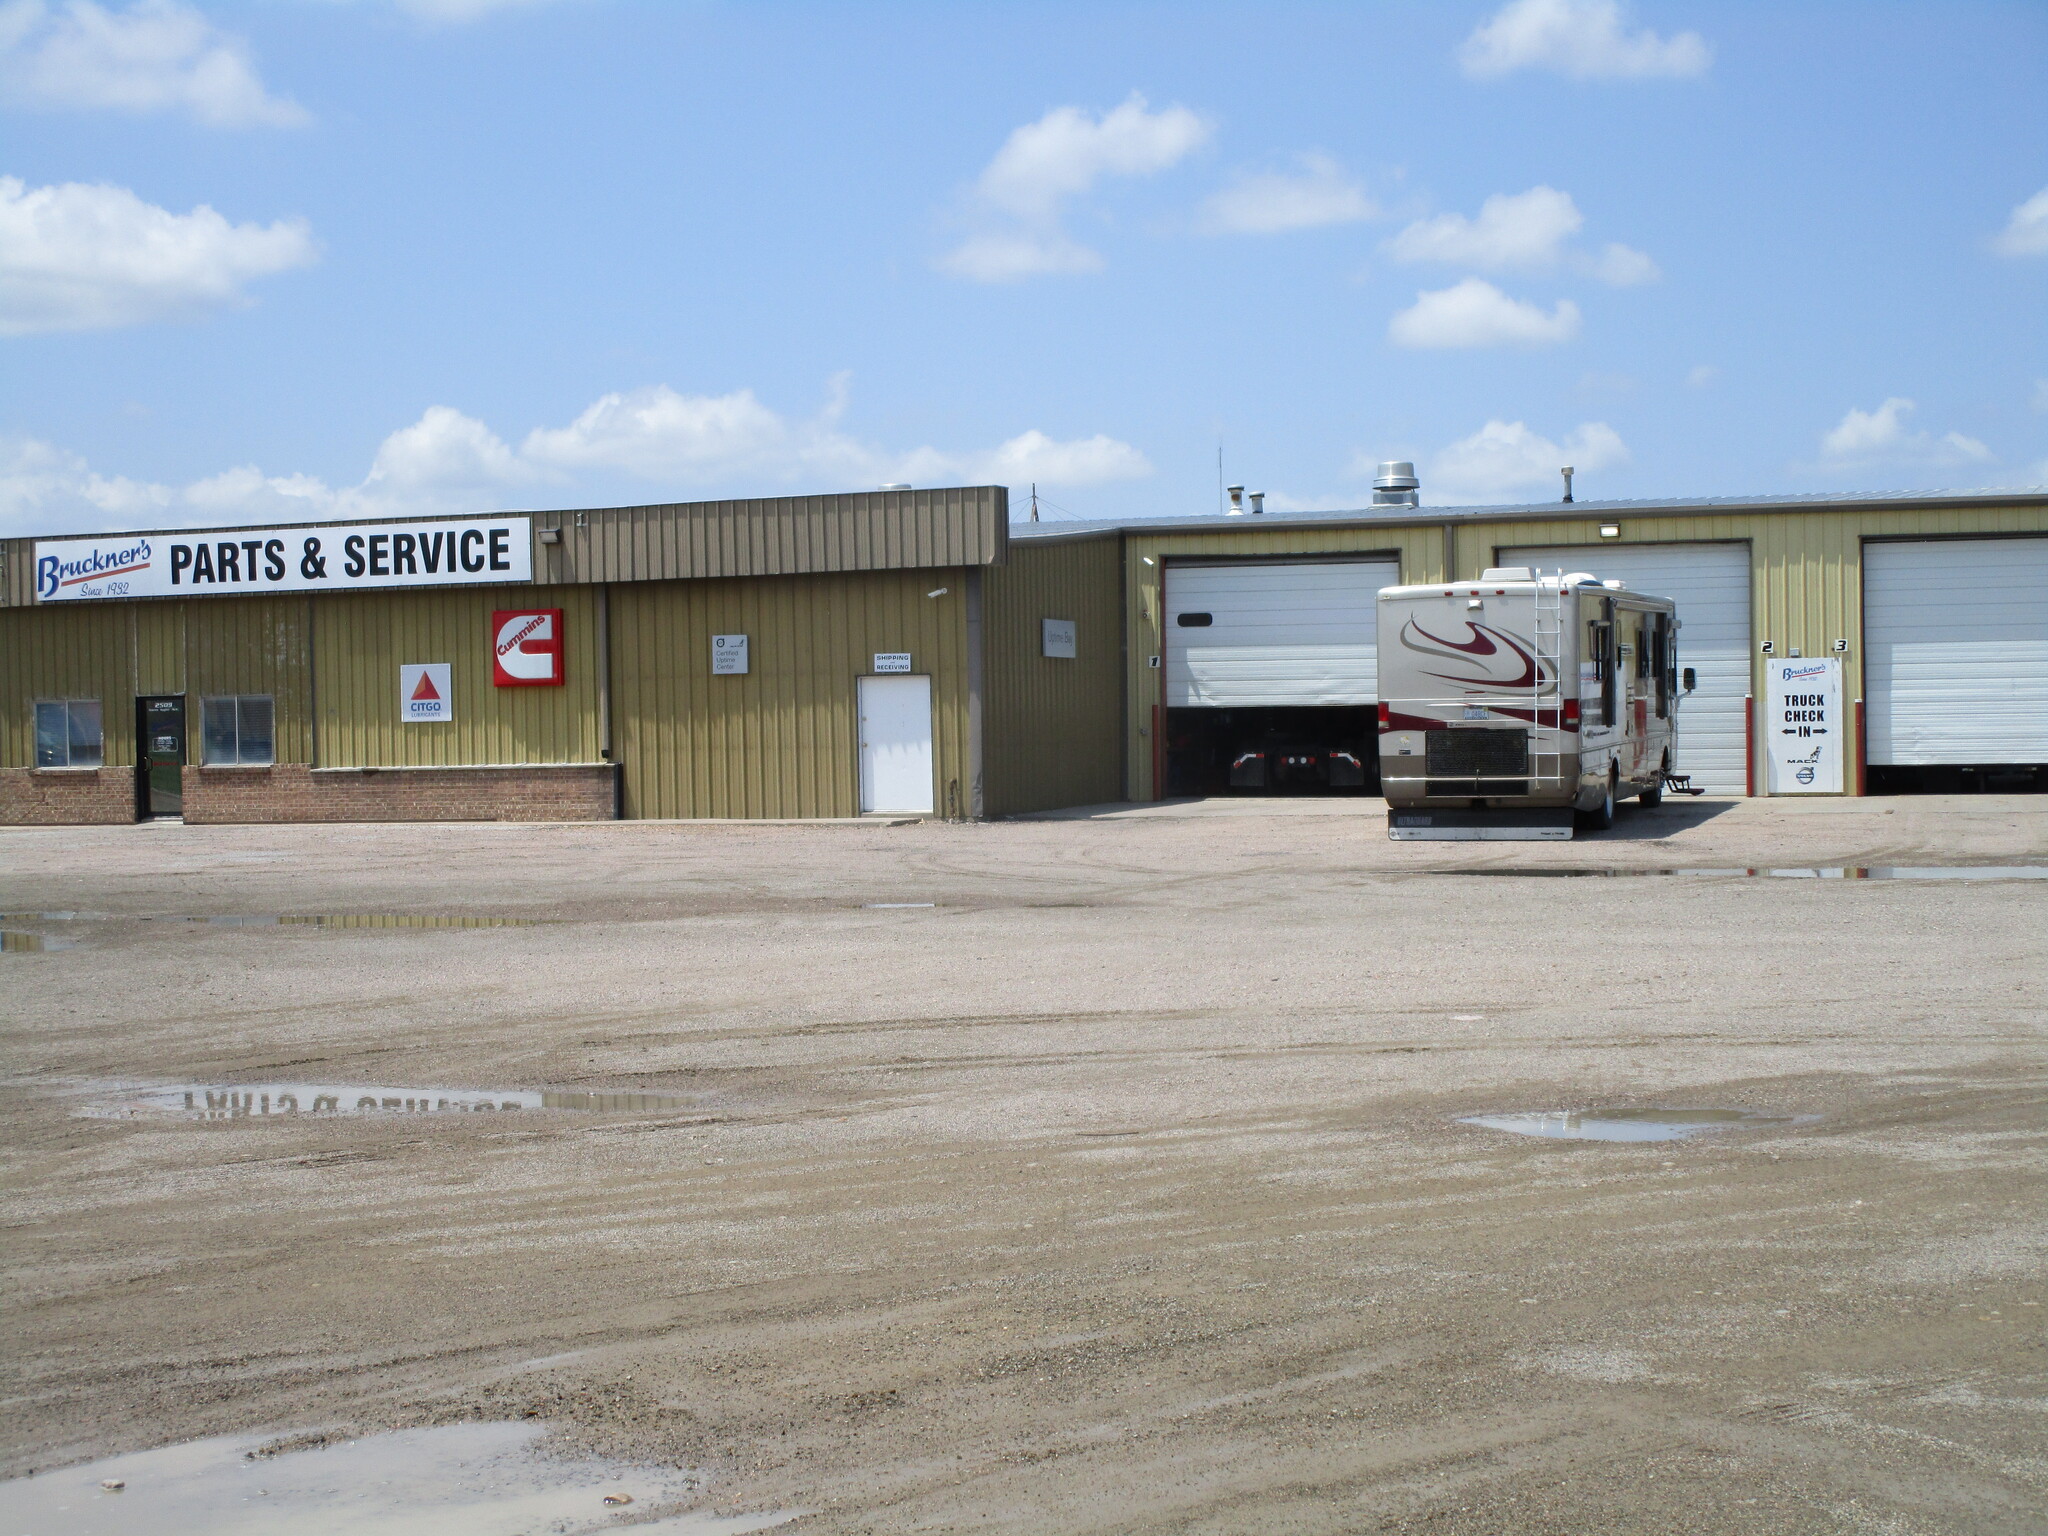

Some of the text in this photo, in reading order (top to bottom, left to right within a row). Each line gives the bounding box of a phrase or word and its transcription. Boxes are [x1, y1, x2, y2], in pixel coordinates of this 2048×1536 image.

[170, 528, 511, 585] PARTS & SERVICE
[37, 539, 152, 598] Bruckner's
[80, 582, 130, 597] Since 1932
[497, 615, 546, 657] Cummins
[1762, 641, 1773, 652] 2
[1836, 640, 1847, 651] 3
[1151, 656, 1159, 667] 1
[1782, 663, 1827, 681] Bruckner's
[1784, 694, 1825, 707] TRUCK
[410, 702, 441, 712] CITGO
[1784, 710, 1825, 722] CHECK
[1798, 726, 1811, 738] IN
